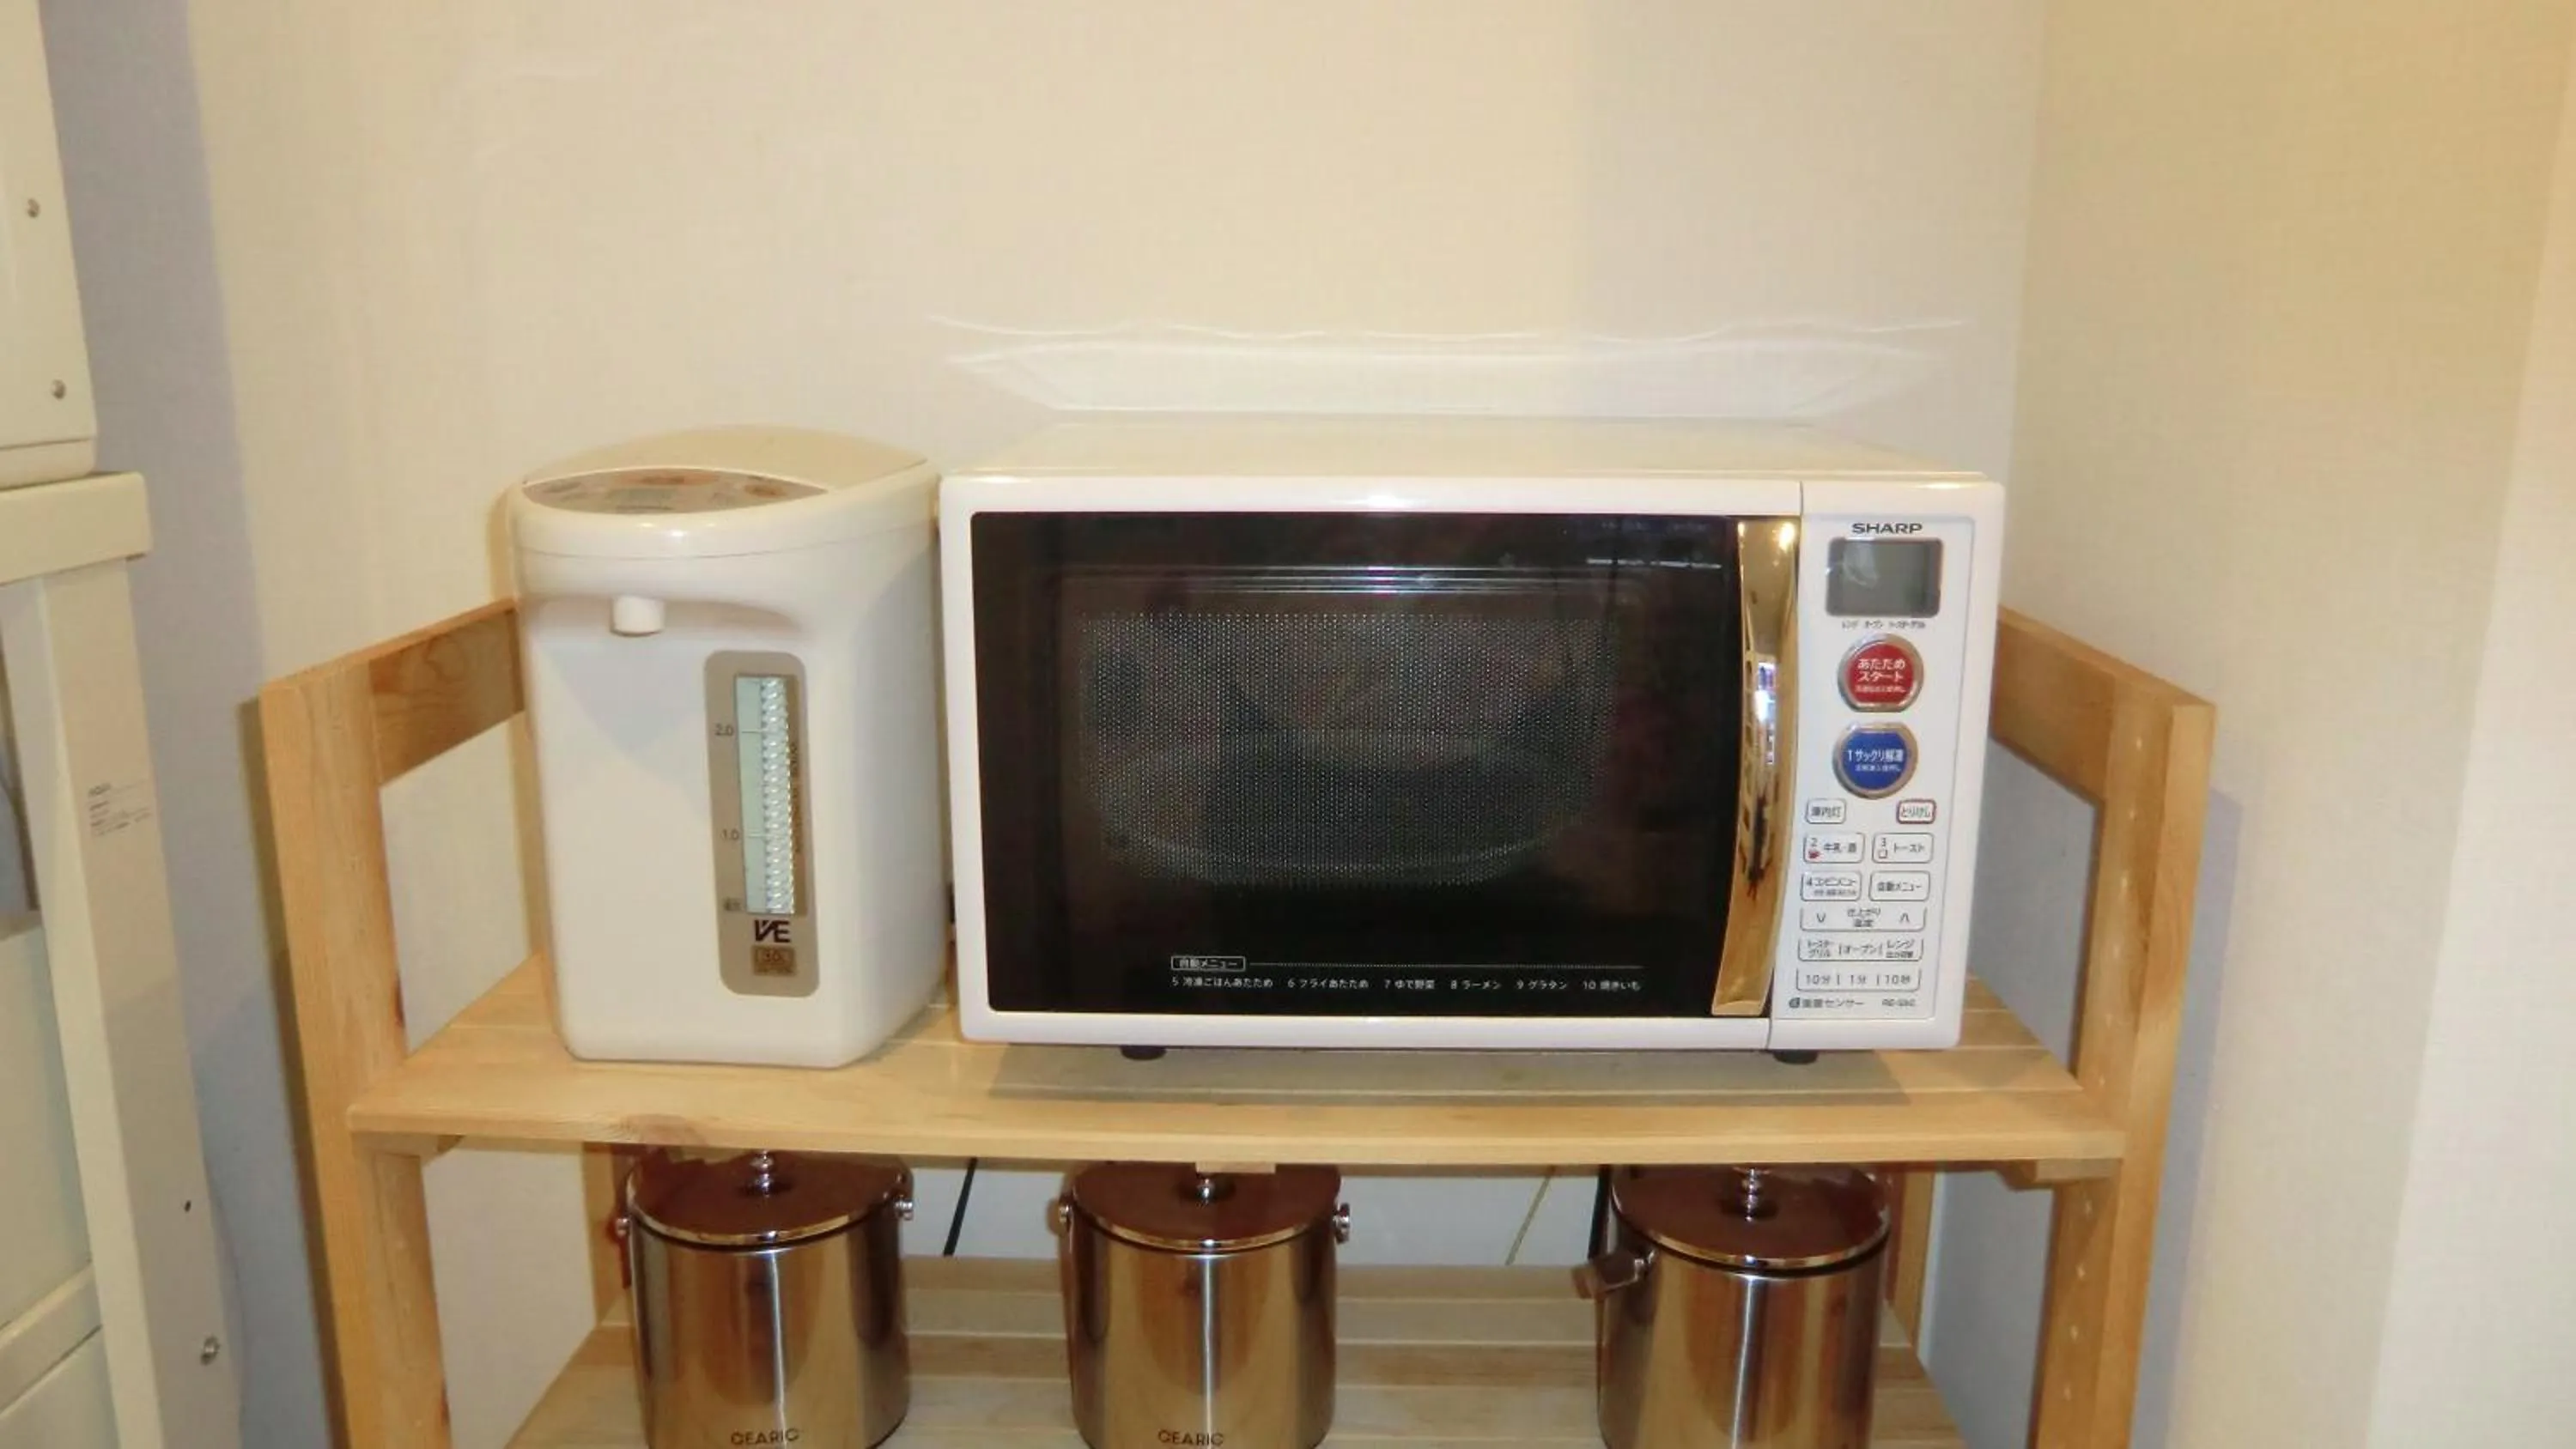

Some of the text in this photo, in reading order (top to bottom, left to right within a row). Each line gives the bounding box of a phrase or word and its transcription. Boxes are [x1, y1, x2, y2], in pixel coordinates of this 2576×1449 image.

[1852, 523, 1923, 534] SHARP
[1857, 658, 1905, 670] あたため
[1858, 670, 1904, 682] スタート
[714, 723, 734, 737] 2.0
[1901, 805, 1931, 818] とりけし
[721, 828, 739, 840] 1.0
[1811, 837, 1818, 847] 2
[1880, 837, 1887, 847] 3
[1893, 842, 1925, 852] トースト
[1886, 938, 1915, 949] レンジ
[1843, 944, 1878, 955] オーブン
[1171, 977, 1180, 987] 5
[1287, 978, 1296, 988] 6
[1298, 978, 1370, 989] フライあたため
[1383, 979, 1391, 989] 7
[1450, 979, 1458, 990] 8
[1461, 979, 1502, 991] ラーメン
[1516, 979, 1525, 991] 9
[1528, 979, 1568, 991] グラタン
[1806, 974, 1831, 985] 10分
[1850, 974, 1867, 985] 1分
[1583, 980, 1596, 991] 10
